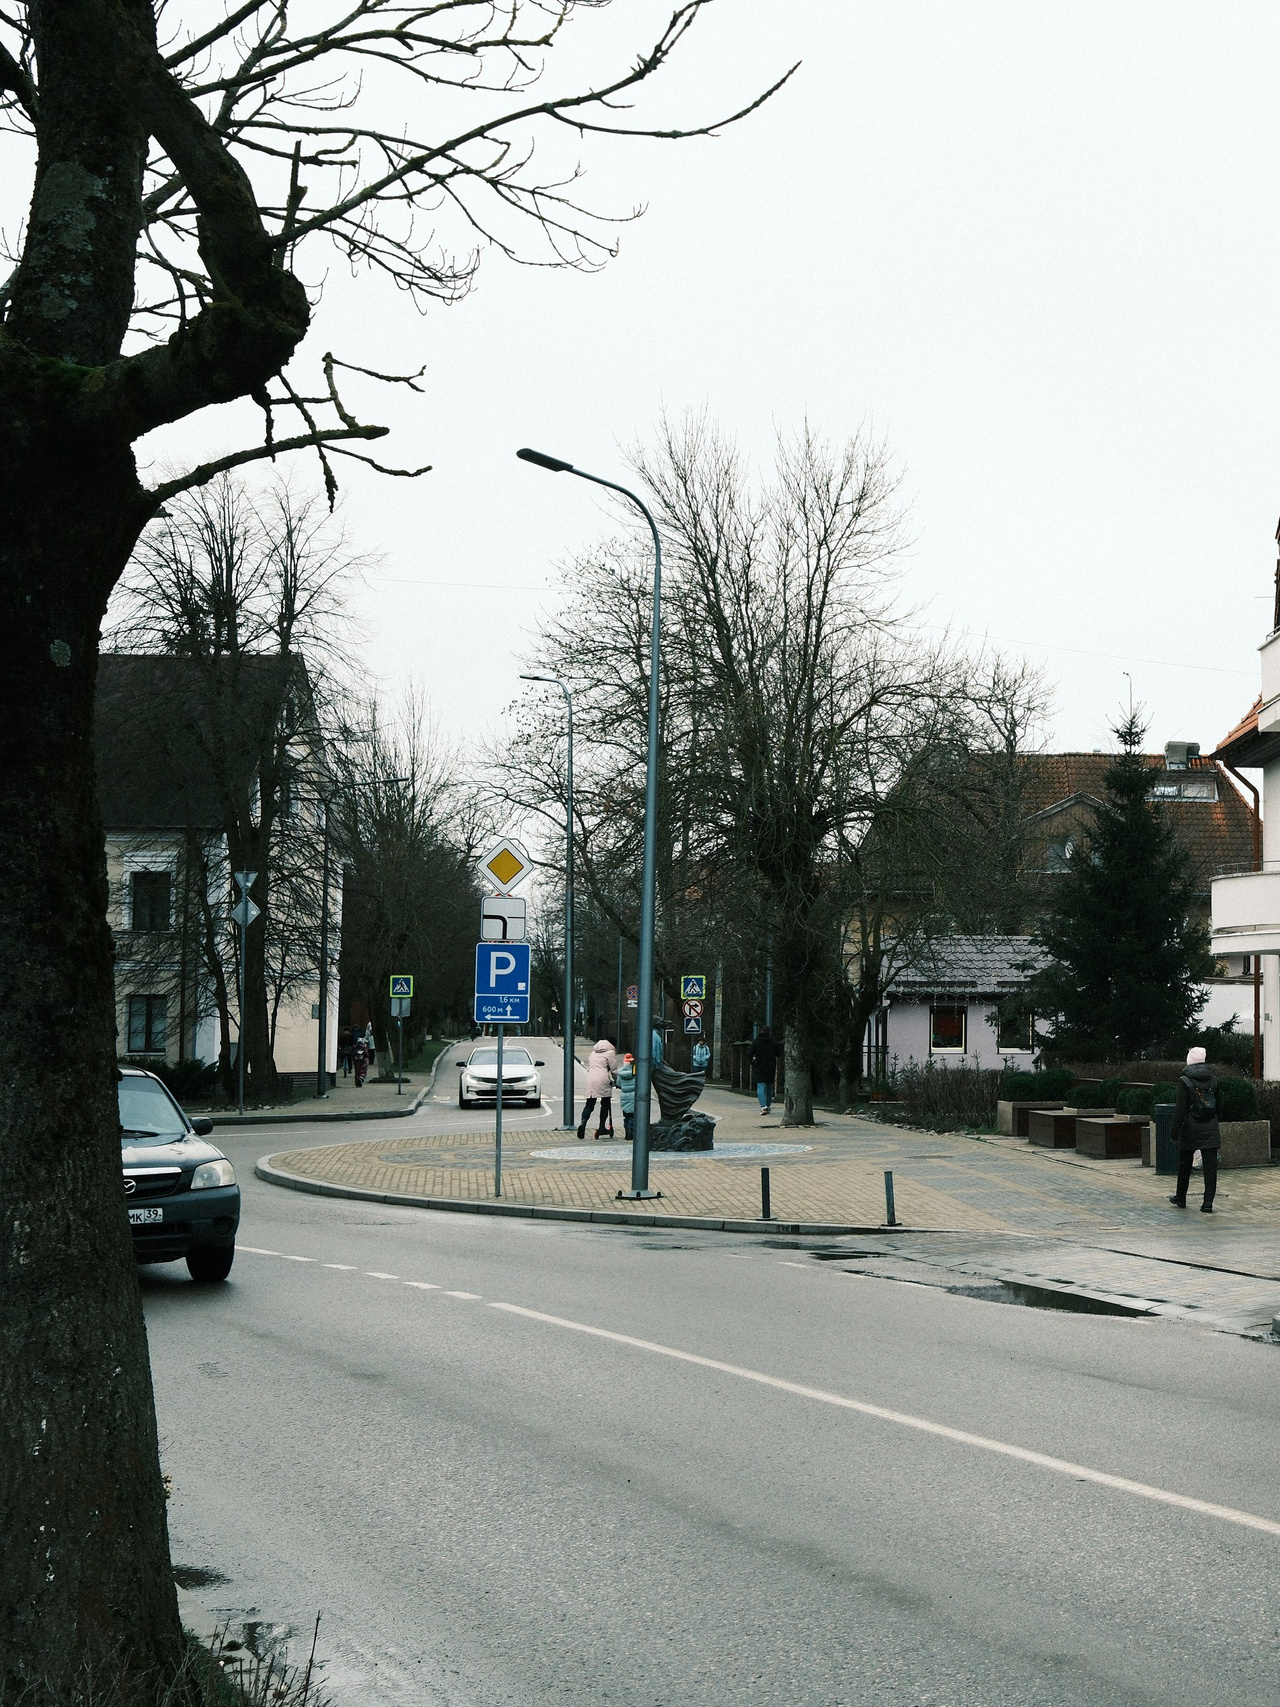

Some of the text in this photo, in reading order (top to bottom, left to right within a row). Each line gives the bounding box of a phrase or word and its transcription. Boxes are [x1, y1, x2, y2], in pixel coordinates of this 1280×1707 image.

[489, 951, 516, 988] P
[482, 1005, 496, 1013] 600
[146, 1209, 159, 1219] 39
